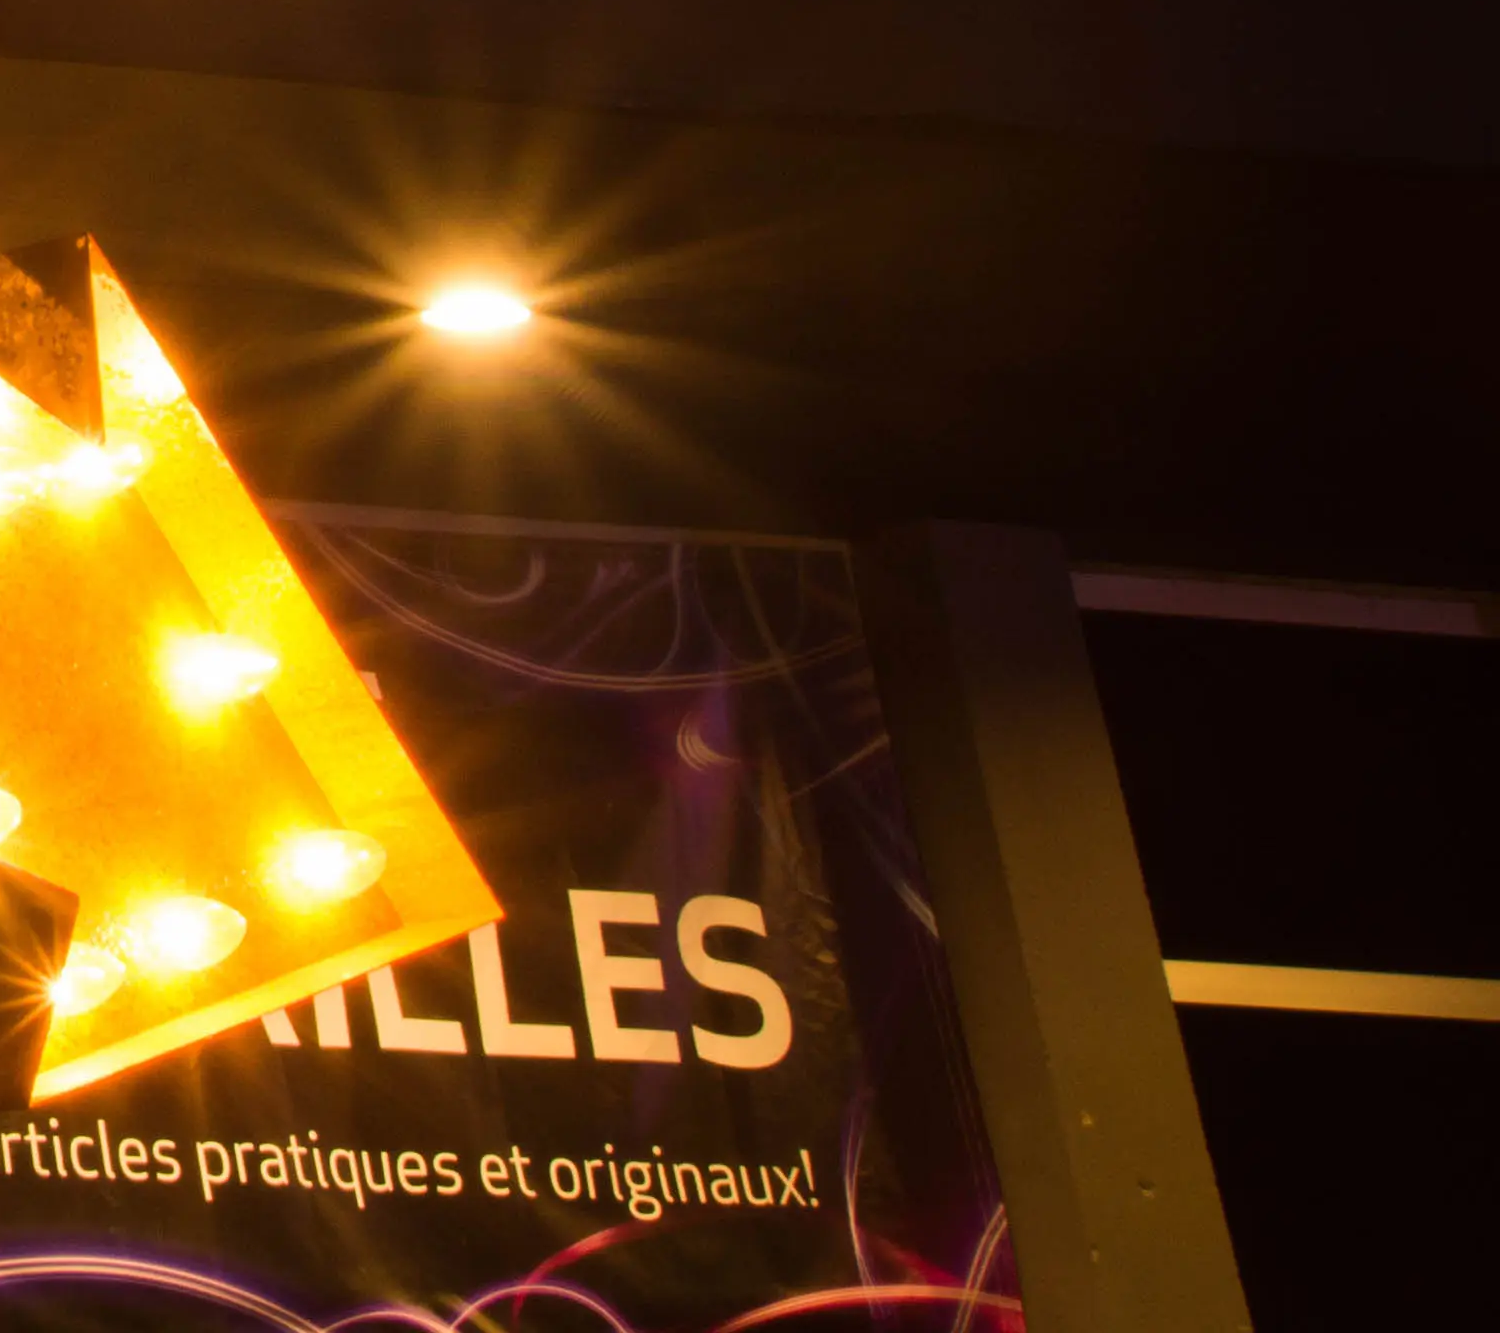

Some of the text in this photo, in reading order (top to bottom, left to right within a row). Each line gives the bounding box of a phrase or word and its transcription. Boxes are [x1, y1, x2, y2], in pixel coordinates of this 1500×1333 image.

[195, 1129, 463, 1210] pratiques
[479, 1144, 538, 1199] et
[548, 1141, 820, 1221] originaux!
